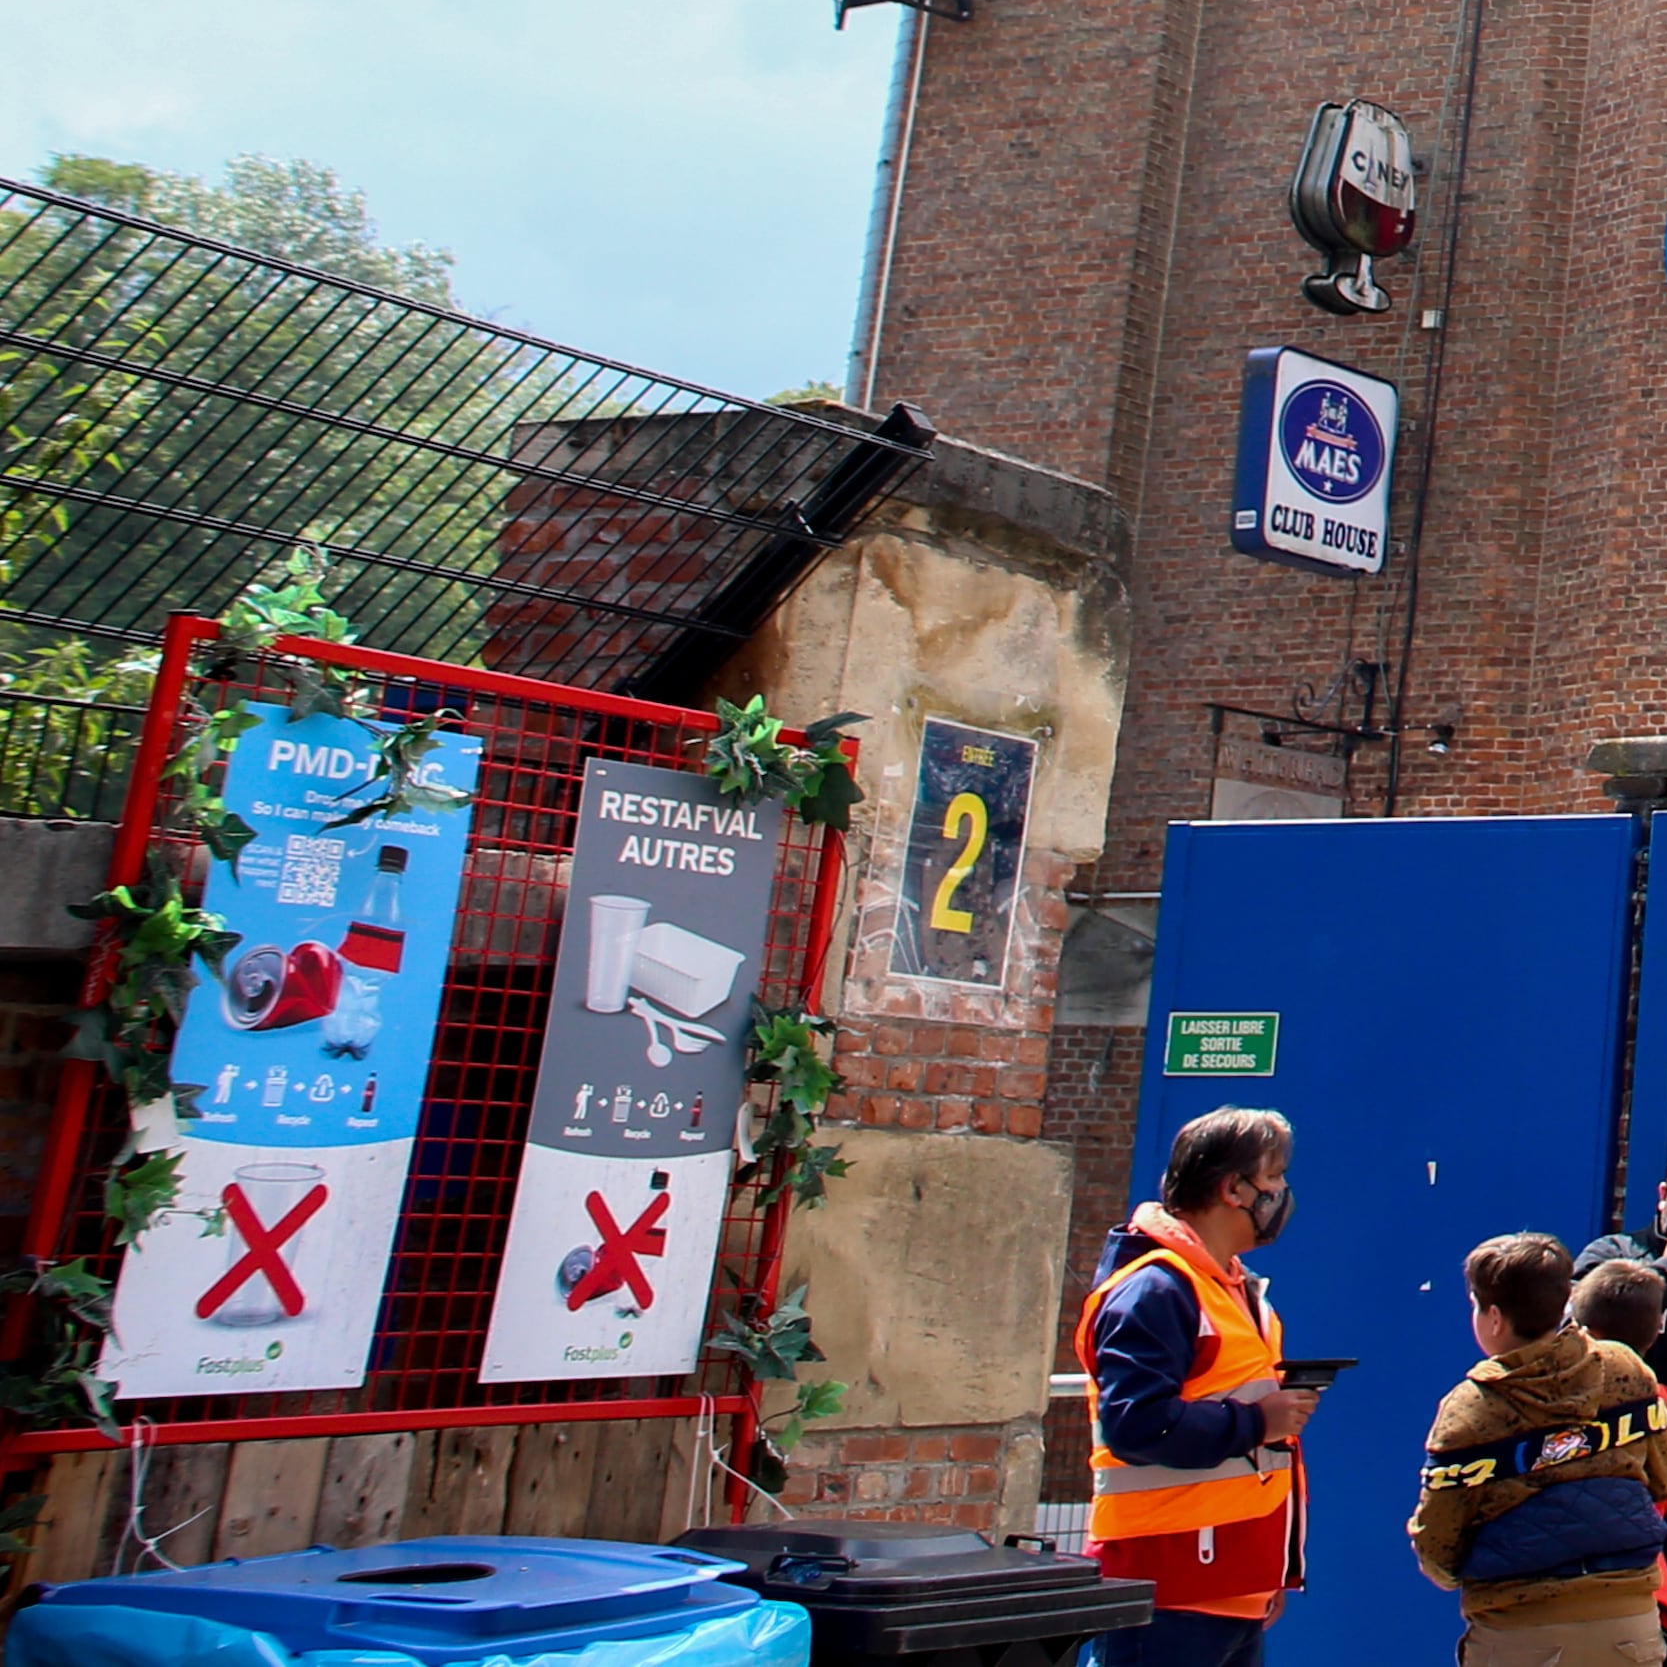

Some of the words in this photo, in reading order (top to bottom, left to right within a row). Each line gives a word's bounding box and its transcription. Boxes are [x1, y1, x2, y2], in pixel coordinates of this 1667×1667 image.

[1294, 439, 1362, 484] MAES
[1271, 505, 1315, 541] CLUB
[1321, 518, 1378, 558] HOUSE
[599, 789, 763, 841] RESTAFVAL
[618, 835, 737, 877] AUTRES
[930, 792, 988, 934] 2
[1181, 1020, 1231, 1035] LAISSER
[1232, 1020, 1266, 1035] LIBRE
[1200, 1037, 1243, 1052] SORTIE
[1182, 1053, 1199, 1069] DE
[1200, 1053, 1256, 1069] SECOURS
